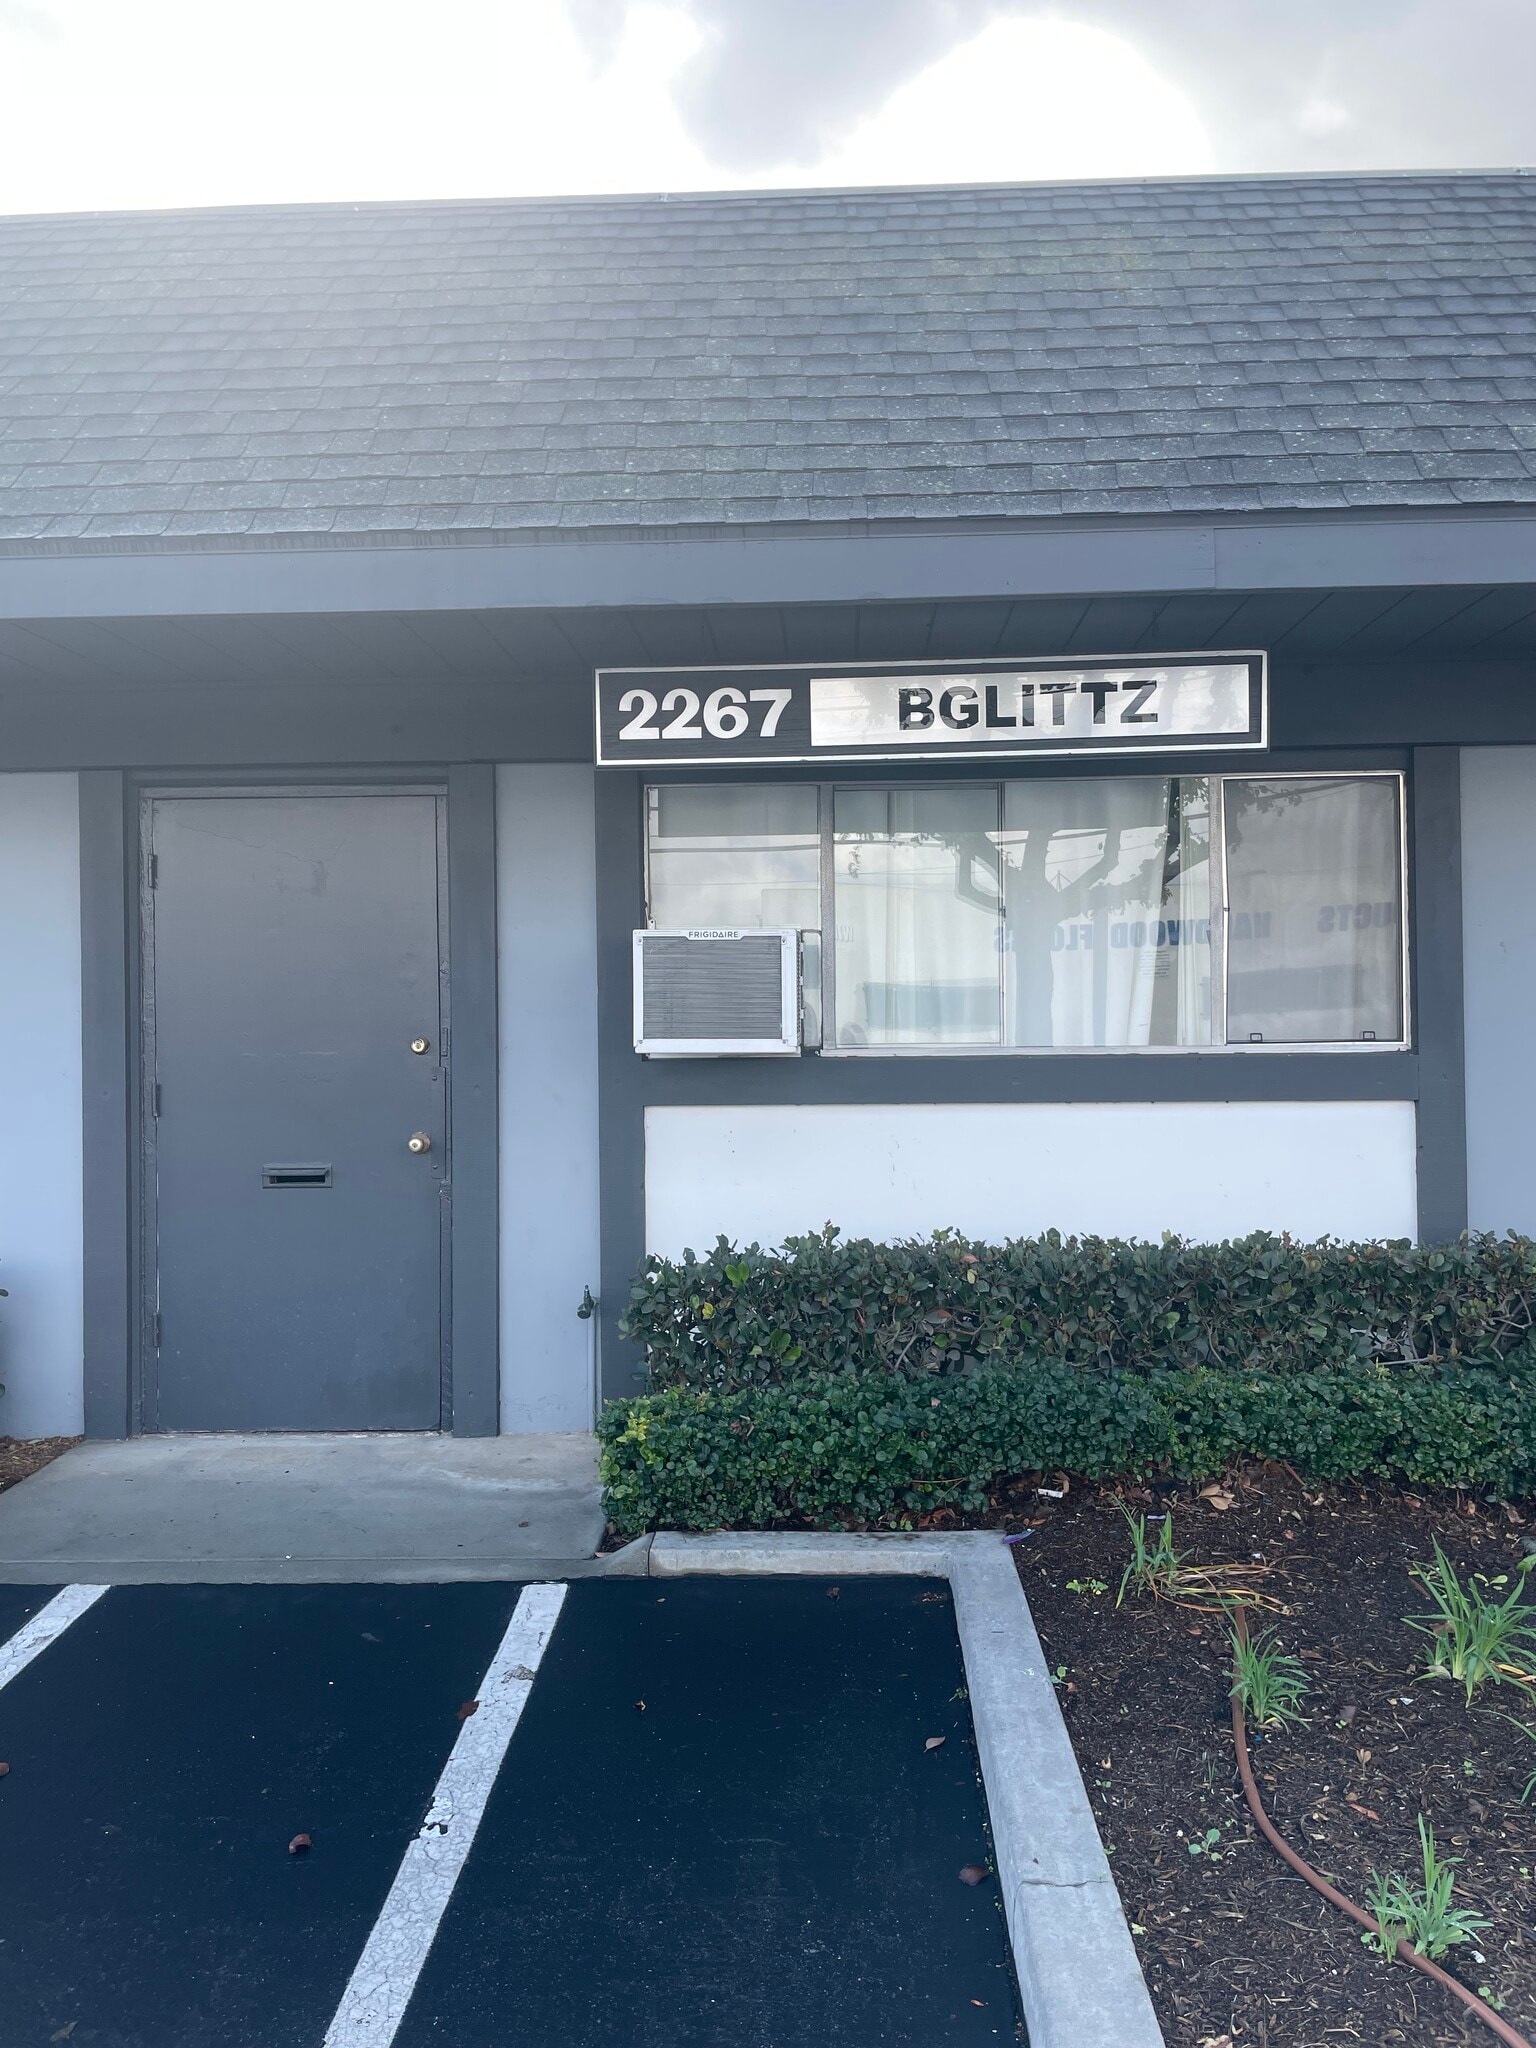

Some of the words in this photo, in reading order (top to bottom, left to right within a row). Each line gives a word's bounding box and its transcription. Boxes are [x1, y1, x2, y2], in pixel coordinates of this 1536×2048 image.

[618, 687, 792, 740] 2267
[898, 680, 1159, 731] BGLITTZ
[688, 930, 739, 938] FRIGIDAIRE
